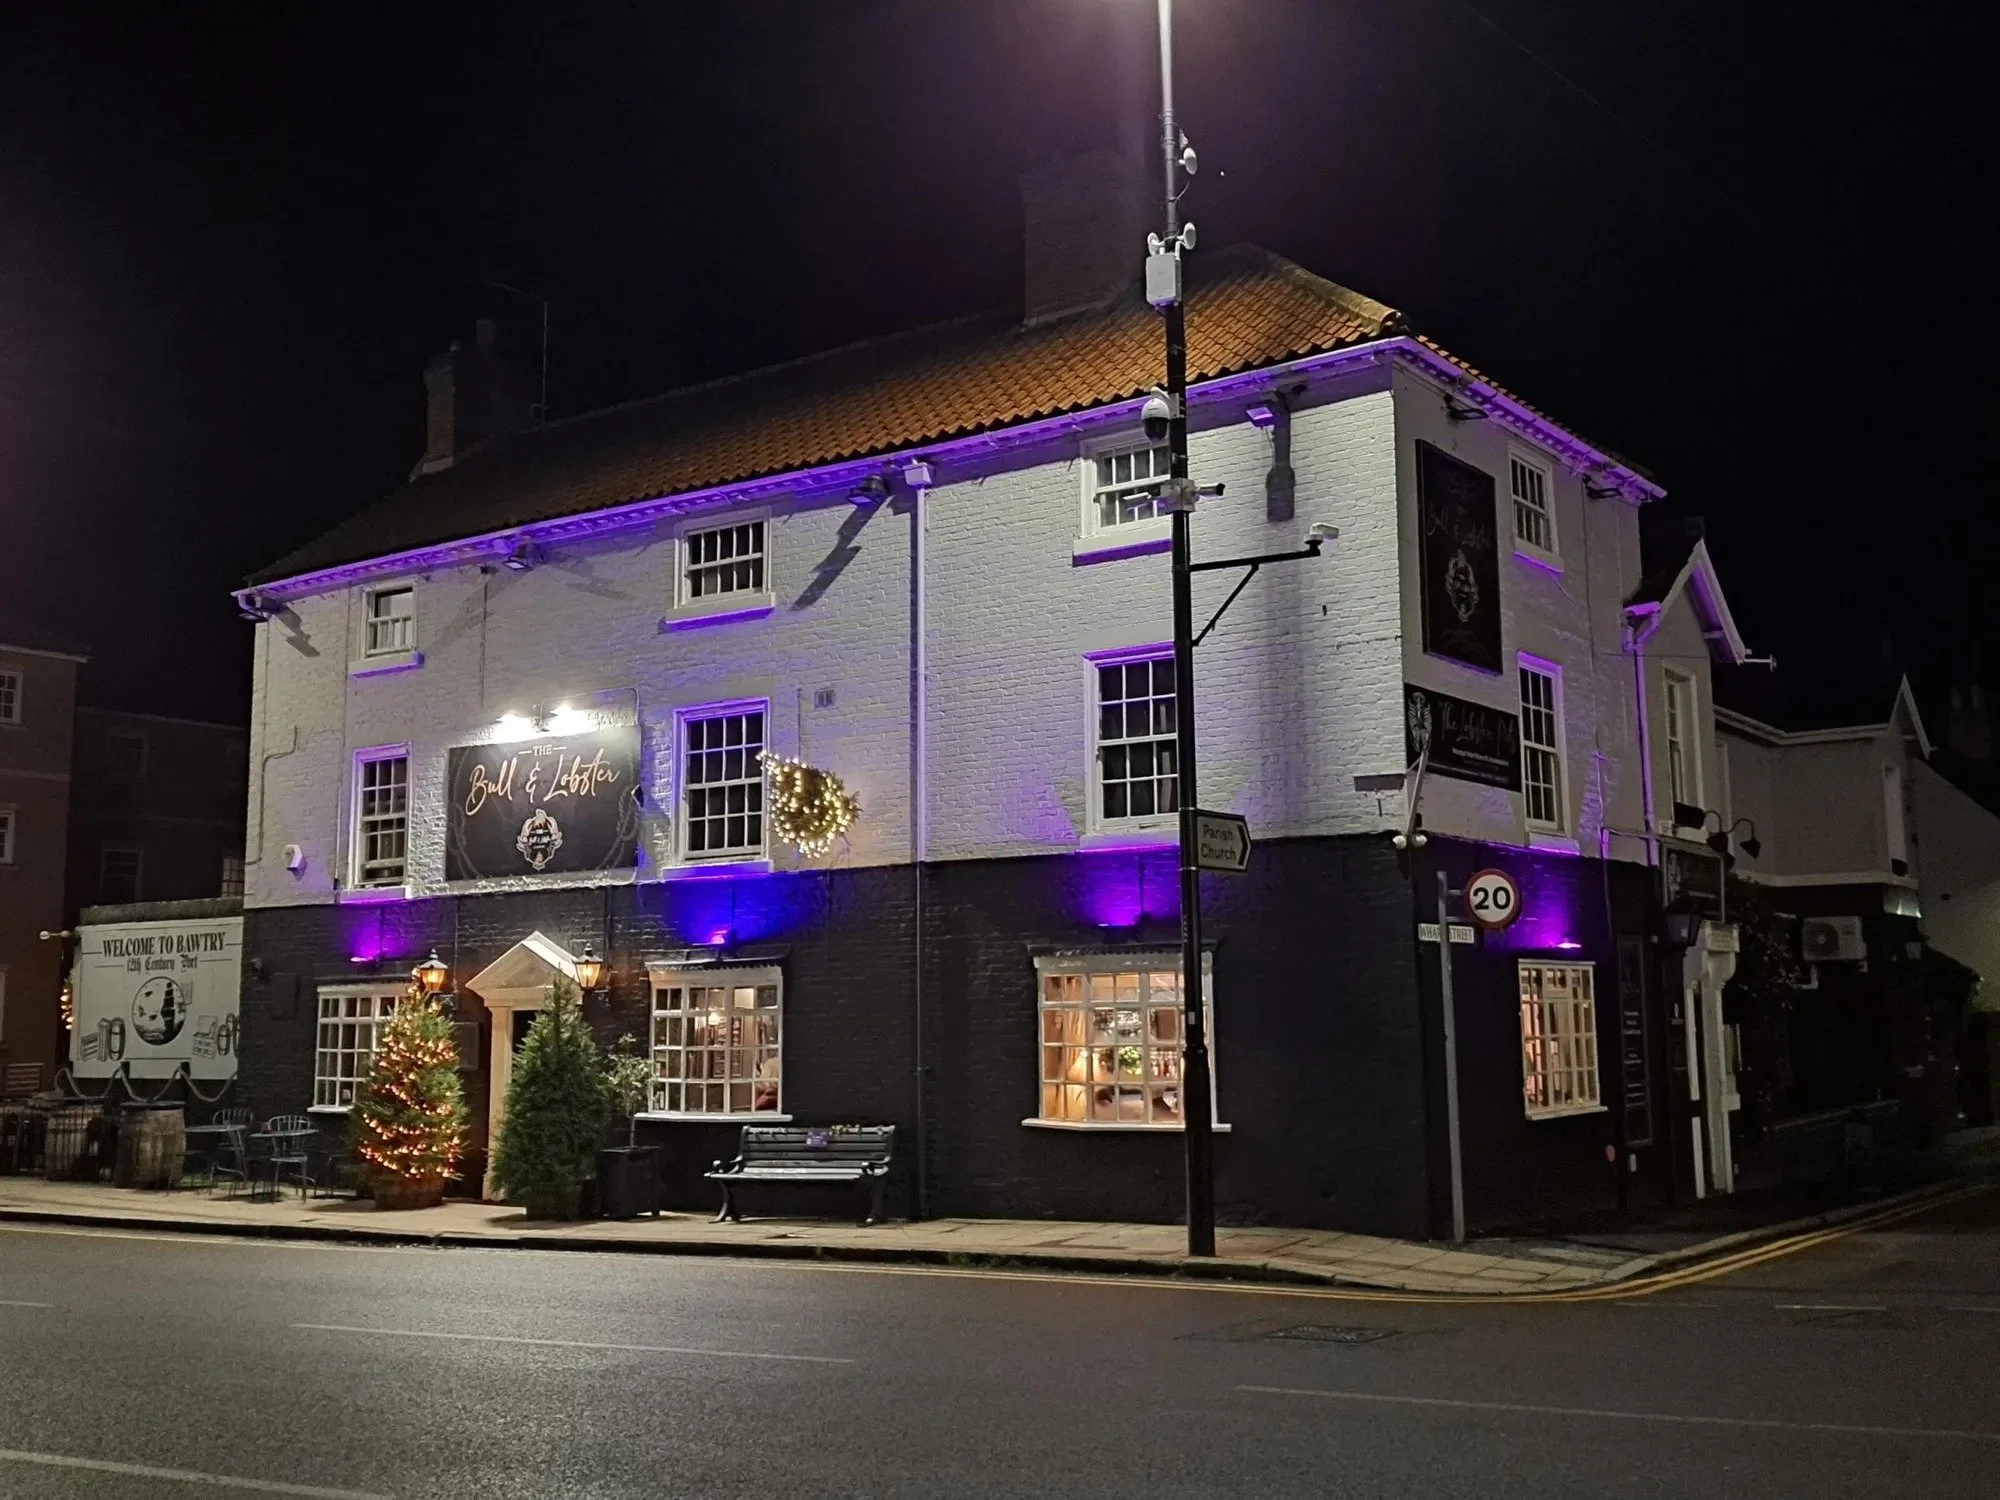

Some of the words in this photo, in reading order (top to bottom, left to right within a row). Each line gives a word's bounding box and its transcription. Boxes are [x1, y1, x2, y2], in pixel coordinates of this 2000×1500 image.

[532, 744, 552, 756] THE
[465, 756, 517, 816] Bull
[525, 761, 541, 803] &
[543, 748, 620, 801] Lobster
[1203, 823, 1233, 841] Parish
[1201, 843, 1237, 861] Church
[1473, 886, 1511, 910] 20
[102, 937, 155, 957] WELCOME
[159, 935, 173, 954] TO
[176, 932, 226, 953] BAWTRY
[127, 958, 141, 973] 12th
[145, 957, 175, 972] Century
